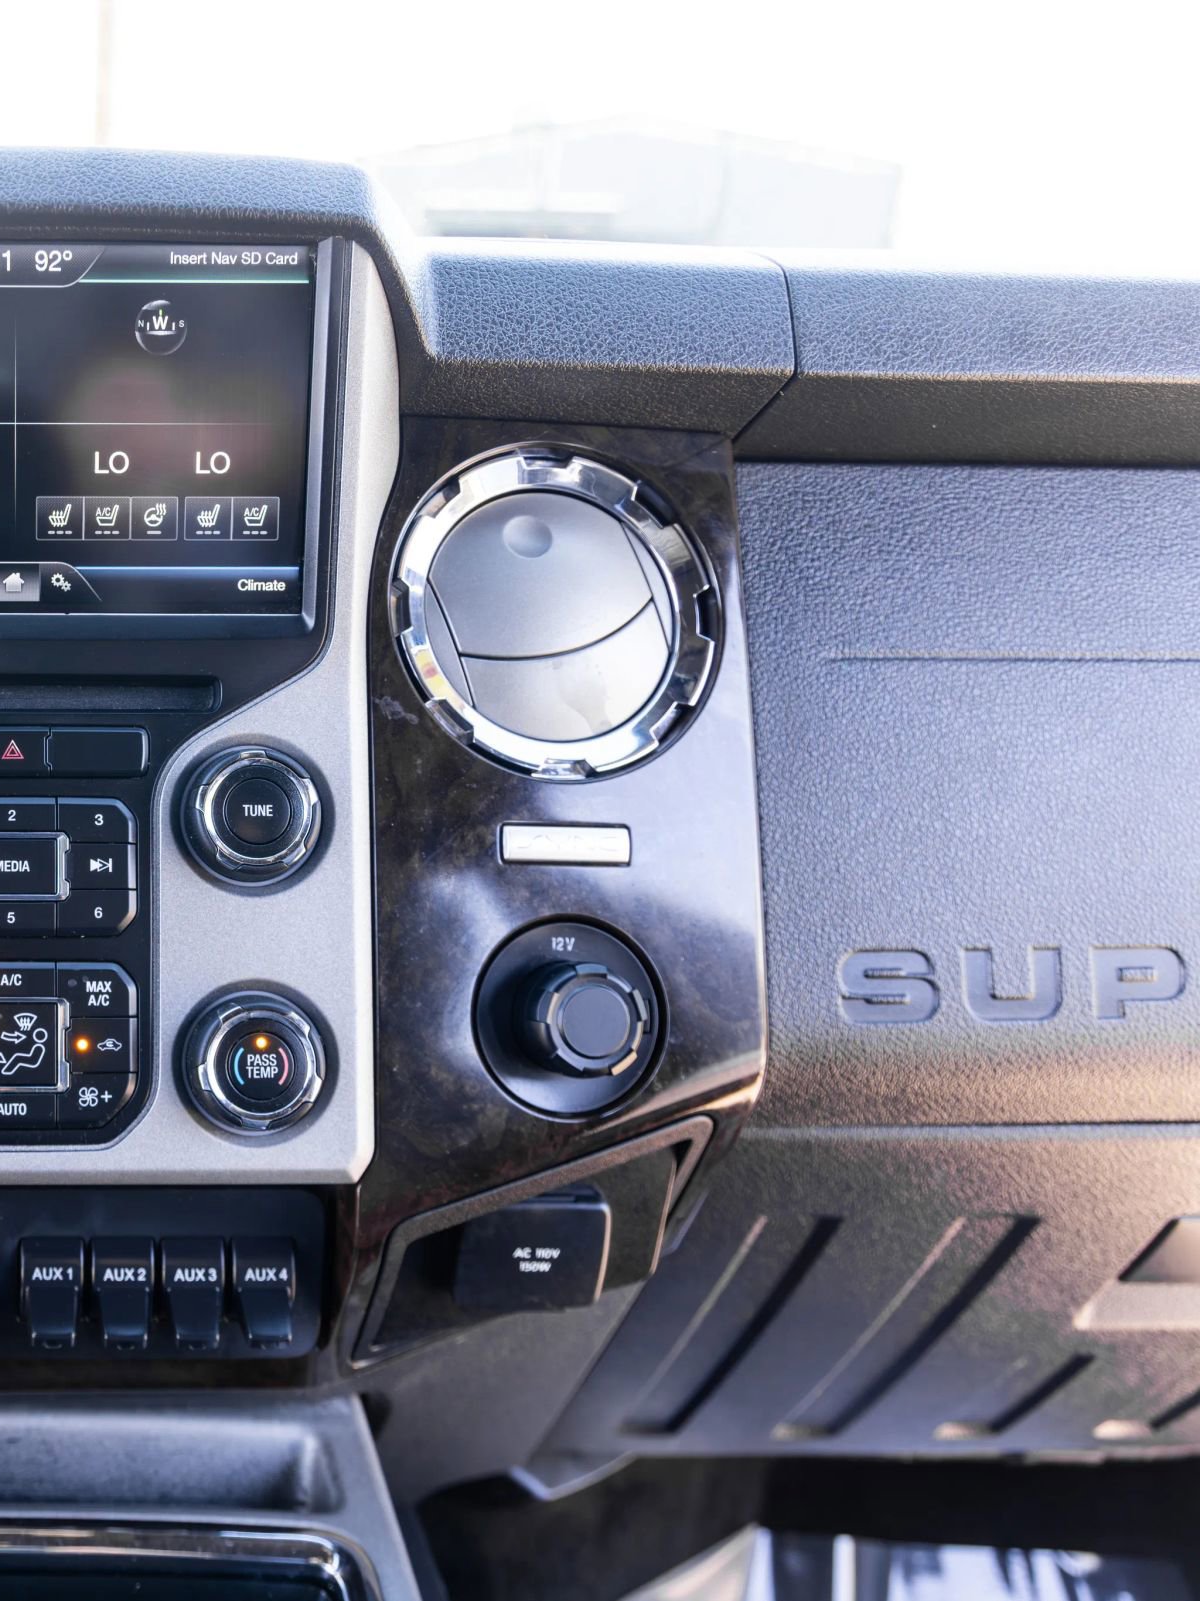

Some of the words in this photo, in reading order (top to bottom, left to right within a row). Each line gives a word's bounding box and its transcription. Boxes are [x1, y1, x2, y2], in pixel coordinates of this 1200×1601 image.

[170, 252, 208, 265] Insert
[211, 252, 238, 265] Nav
[241, 252, 262, 266] SD
[265, 252, 298, 266] Card
[137, 319, 145, 328] N
[152, 315, 169, 330] W
[178, 319, 185, 328] S
[94, 451, 130, 475] LO
[195, 451, 231, 475] LO
[237, 579, 286, 592] Climate
[8, 809, 16, 822] 2
[242, 804, 273, 818] TUNE
[94, 813, 104, 826] 3
[7, 912, 16, 924] 5
[94, 907, 103, 919] 6
[551, 936, 576, 952] 12V
[0, 974, 22, 987] A/C
[86, 981, 112, 993] MAX
[836, 945, 1187, 1024] SUP
[88, 994, 110, 1007] A/C
[247, 1054, 277, 1067] PASS
[246, 1066, 279, 1080] TEMP
[32, 1267, 63, 1281] AUX
[66, 1267, 73, 1281] 1
[103, 1268, 134, 1282] AUX
[137, 1268, 146, 1282] 2
[174, 1268, 205, 1282] AUX
[208, 1268, 217, 1282] 3
[244, 1268, 276, 1282] AUX
[278, 1268, 288, 1282] 4
